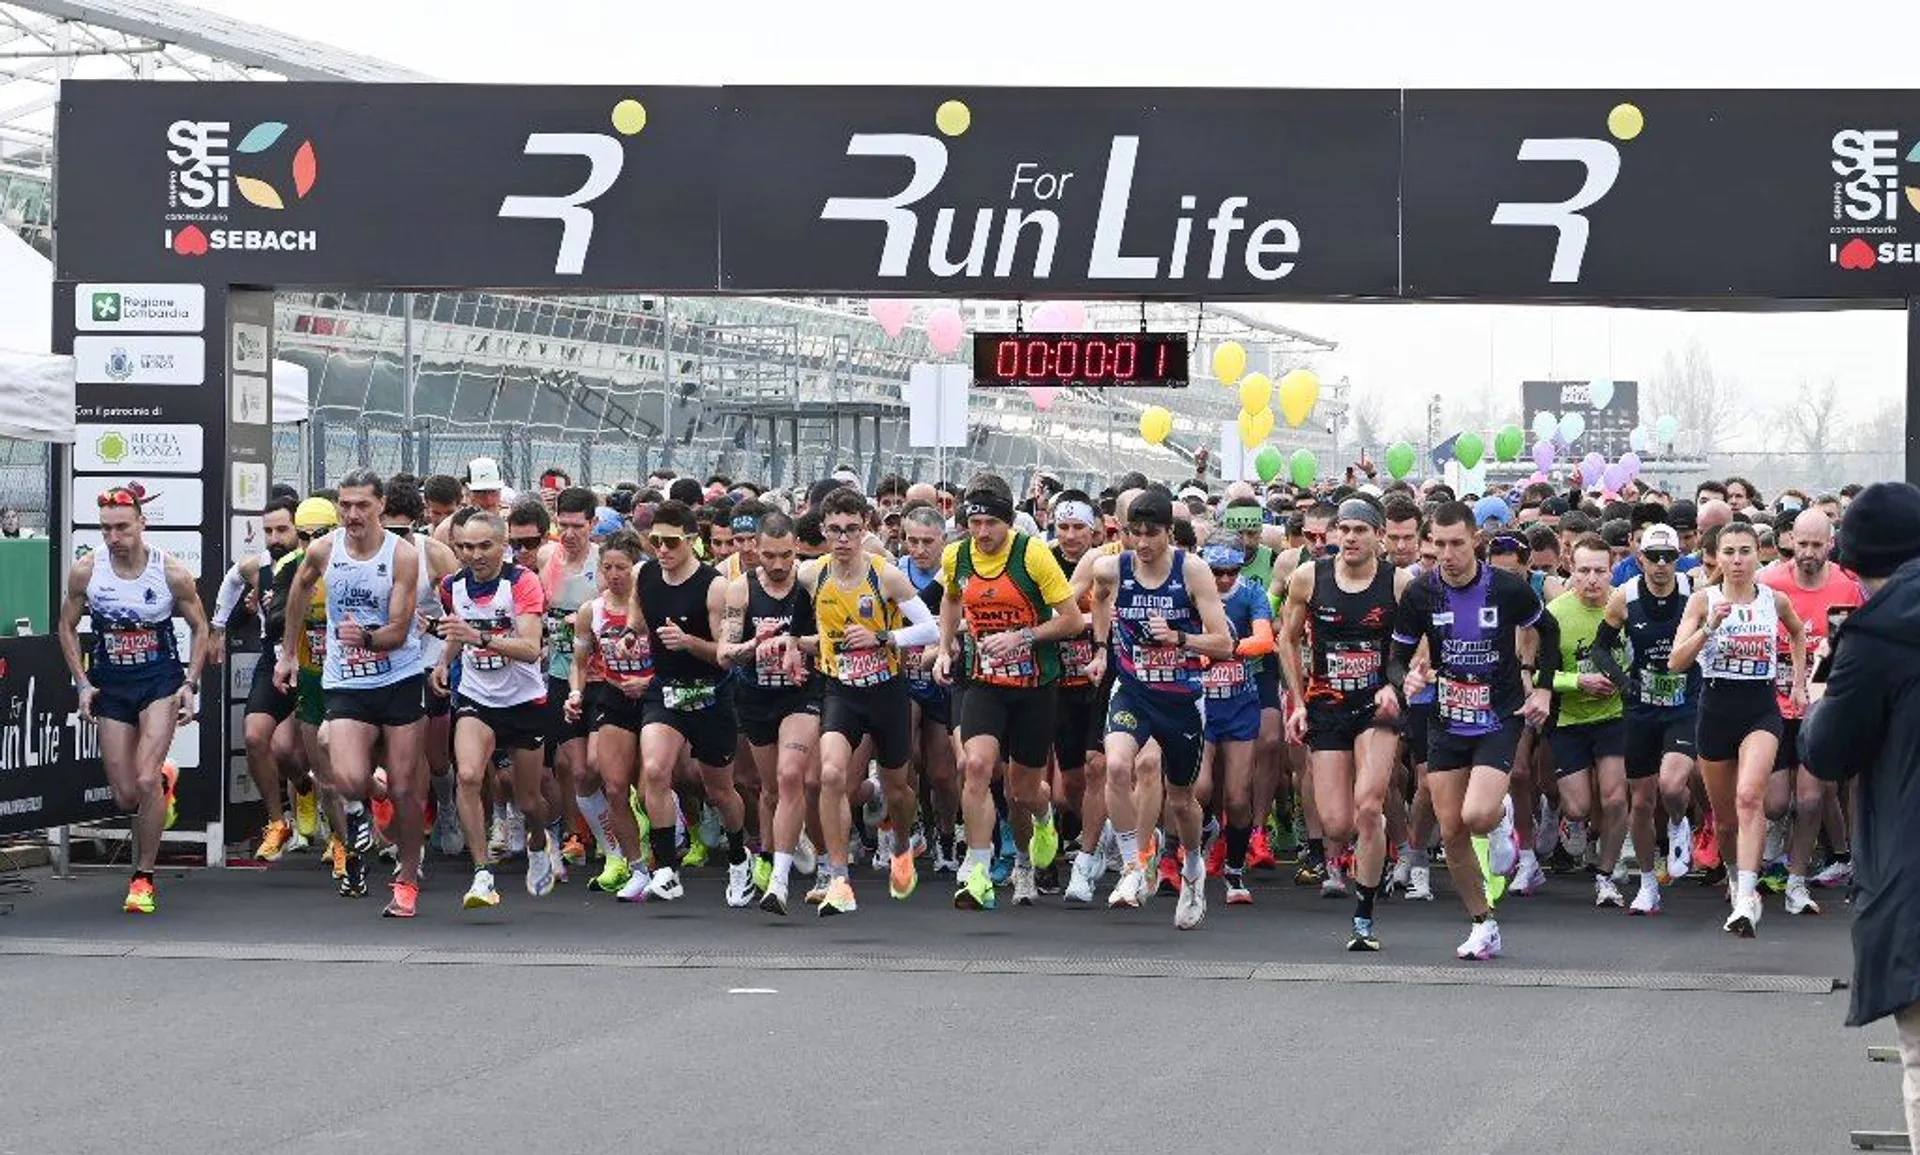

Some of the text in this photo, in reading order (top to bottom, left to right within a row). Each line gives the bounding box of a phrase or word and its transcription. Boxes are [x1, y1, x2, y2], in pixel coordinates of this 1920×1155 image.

[167, 120, 230, 166] SE
[1832, 130, 1899, 175] SE
[1010, 163, 1072, 200] For
[819, 132, 1300, 281] Run Life
[165, 228, 316, 250] I SEBACH
[1830, 225, 1897, 234] concessionario
[1830, 243, 1838, 262] I
[124, 296, 174, 308] Regione
[124, 308, 189, 318] Lombardia
[997, 341, 1165, 377] 00:00:01
[75, 405, 94, 416] Con
[103, 406, 150, 418] patrocinio
[131, 433, 178, 444] REGGIA
[131, 445, 182, 457] MONZA
[971, 611, 1020, 621] SANTI
[25, 675, 60, 768] Life
